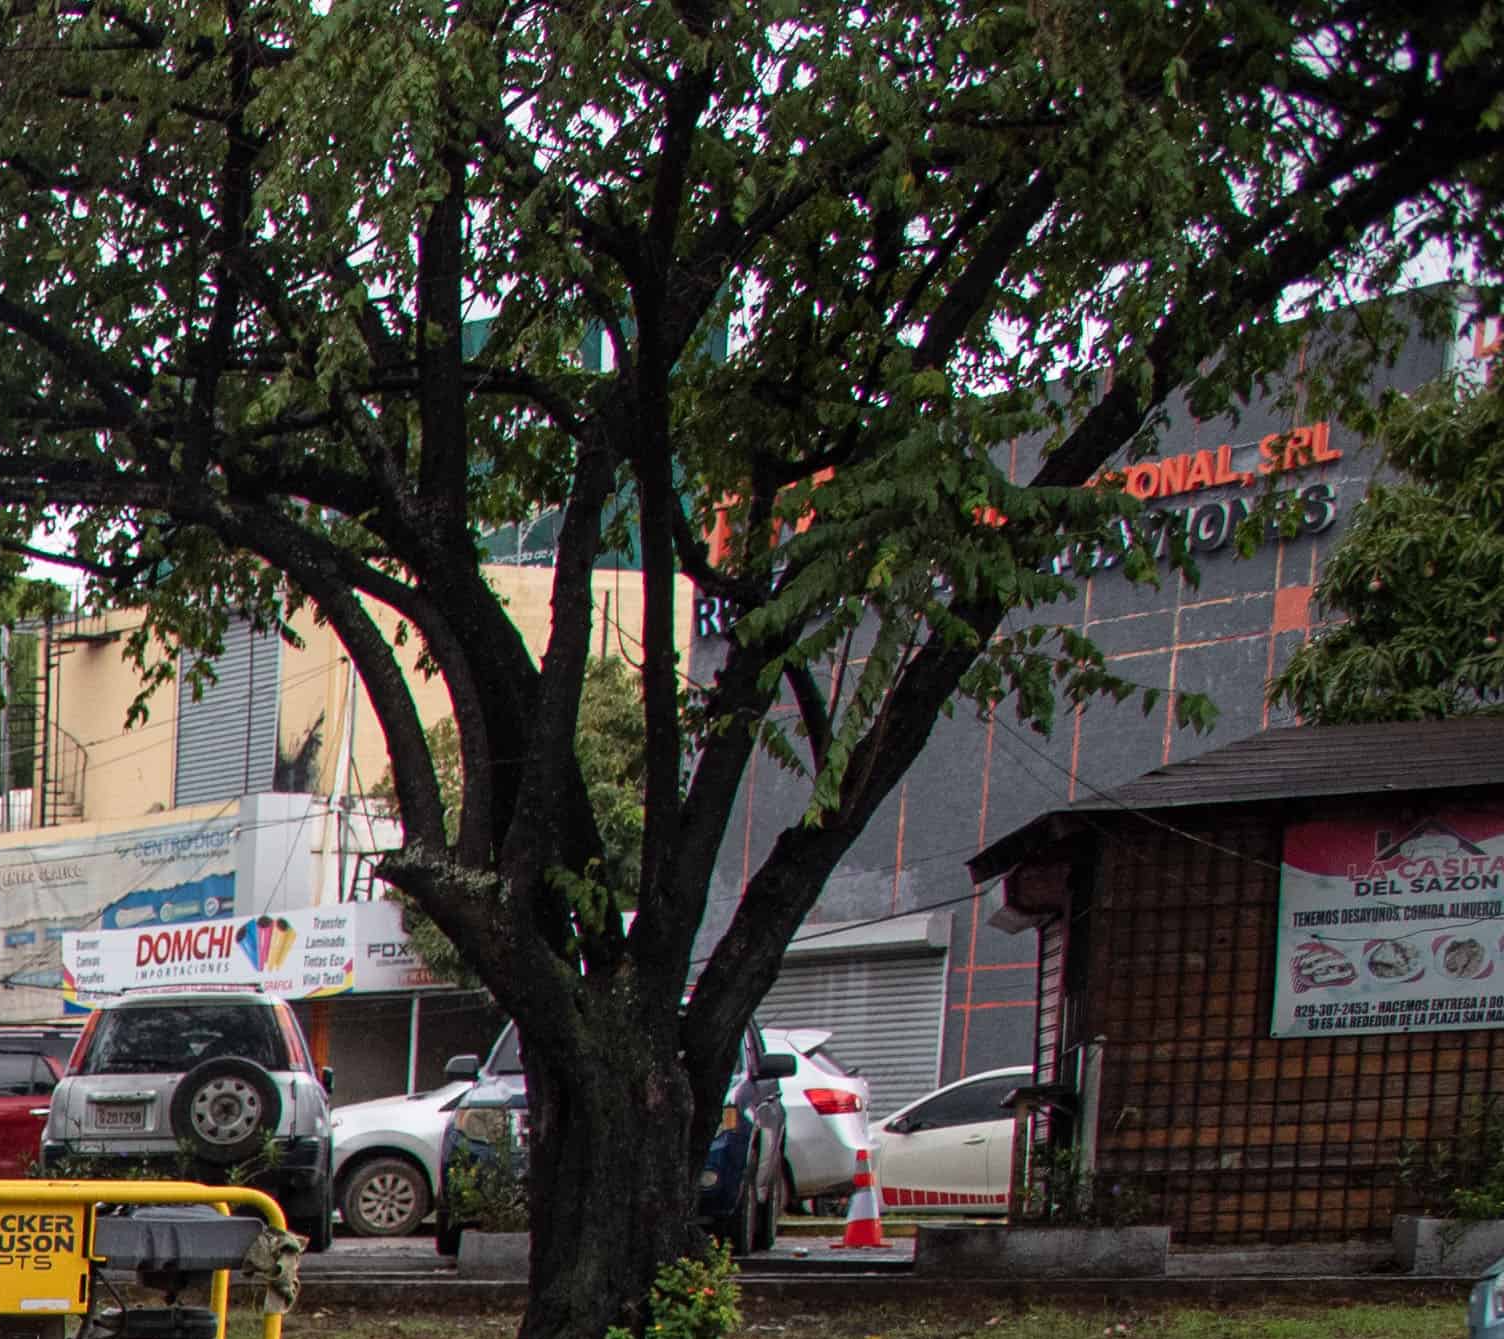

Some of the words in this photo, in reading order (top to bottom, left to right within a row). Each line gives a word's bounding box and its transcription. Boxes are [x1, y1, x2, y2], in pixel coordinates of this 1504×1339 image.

[1258, 420, 1344, 477] SRL
[1346, 862, 1388, 882] LA
[1398, 856, 1504, 880] CASITA
[1354, 880, 1402, 898] DEL
[1410, 873, 1499, 894] SAZÓN
[313, 917, 347, 930] Transfer
[1294, 909, 1339, 928] TENEMOS
[135, 925, 235, 967] DOMCHI
[135, 961, 231, 981] IMPORTACIONES
[1378, 998, 1429, 1013] HACEMOS
[1432, 997, 1477, 1010] ENTREGA
[1398, 1012, 1410, 1026] DE
[1414, 1011, 1426, 1024] LA
[1428, 1010, 1461, 1024] PLAZA
